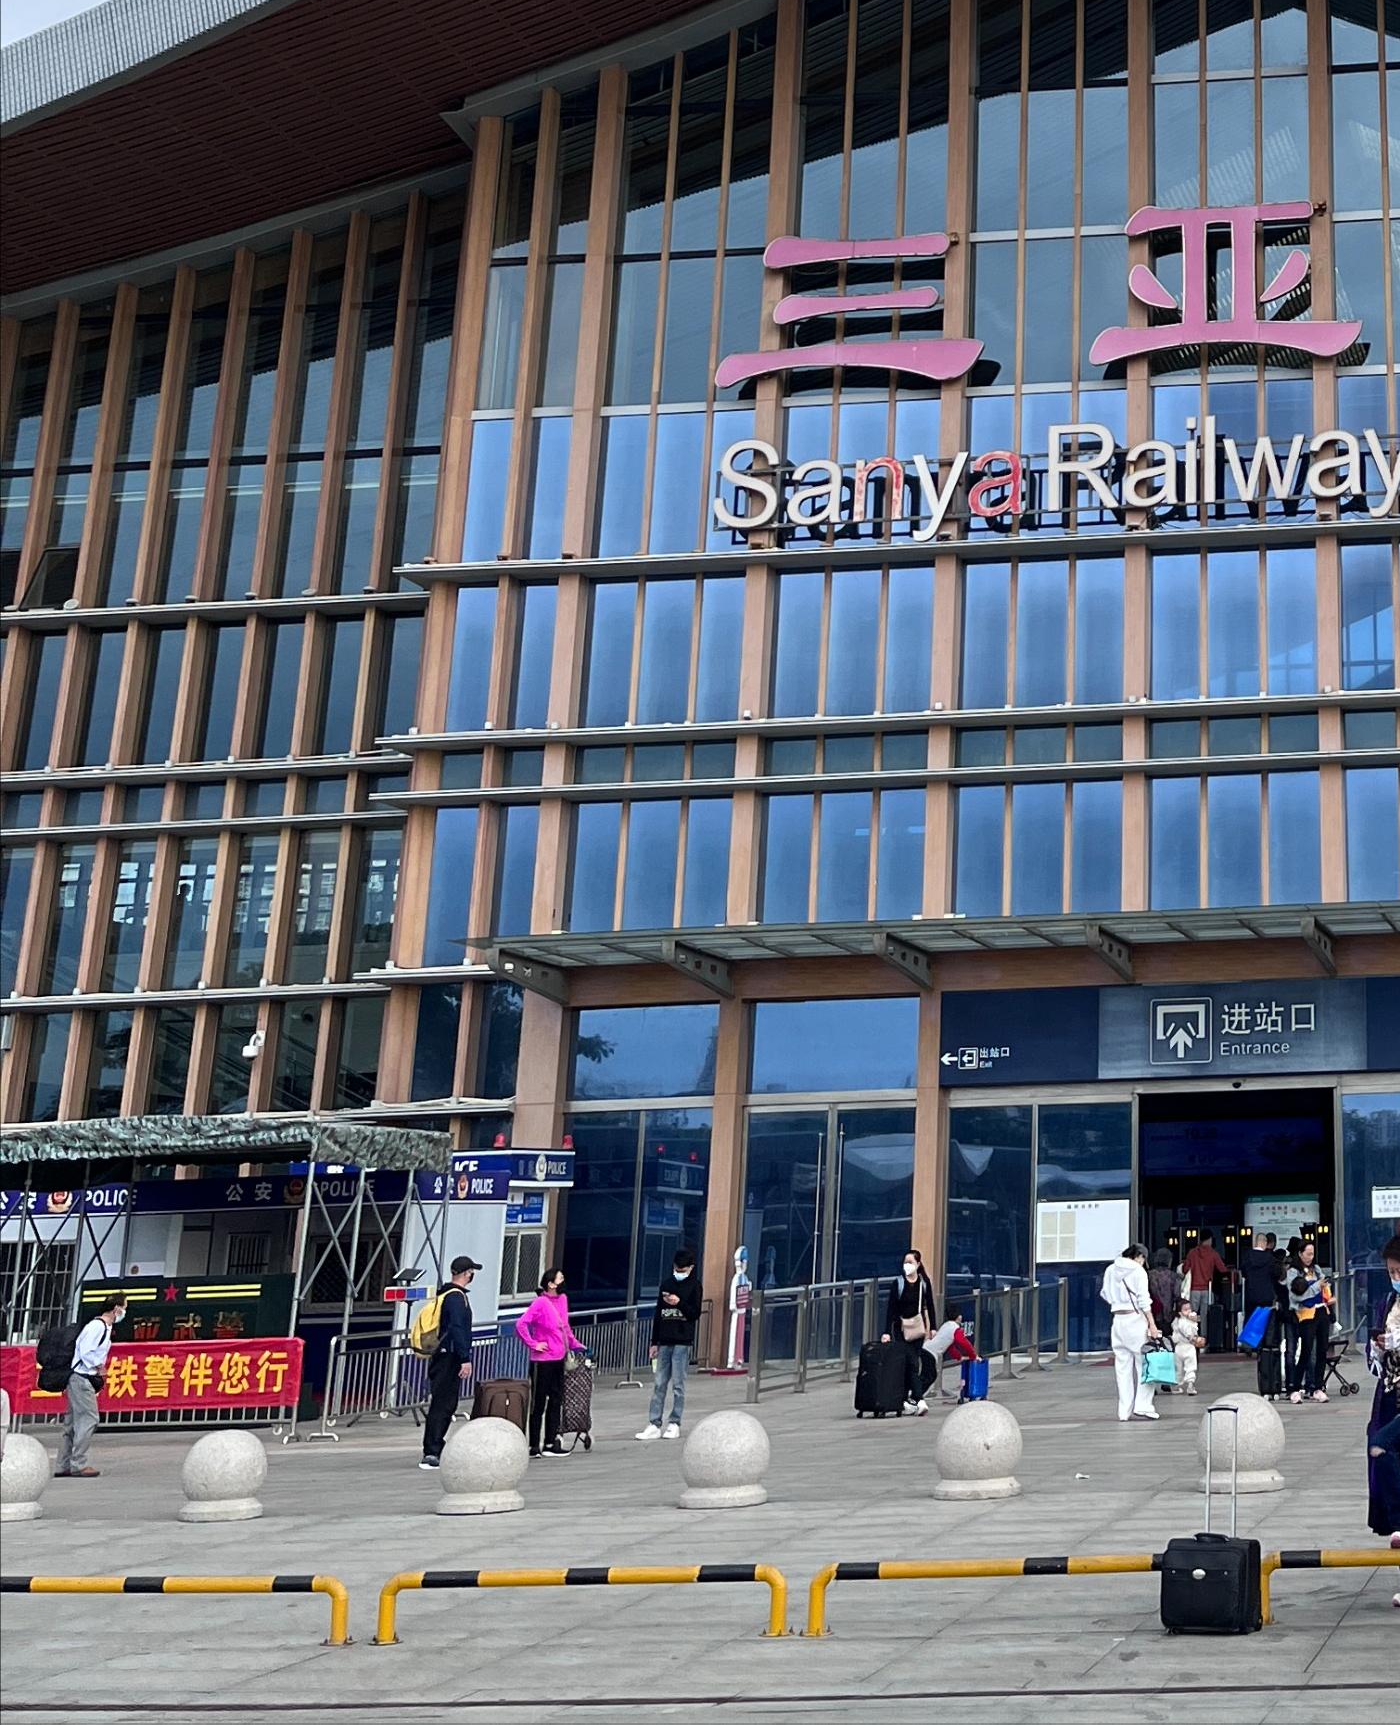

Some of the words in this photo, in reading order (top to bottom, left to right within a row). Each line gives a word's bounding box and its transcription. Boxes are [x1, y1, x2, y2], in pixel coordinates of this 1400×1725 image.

[712, 438, 1024, 542] Sanya
[1220, 1000, 1316, 1035] 进站口
[979, 1046, 1011, 1060] 出站口
[1220, 1041, 1291, 1056] Entrance
[979, 1060, 993, 1069] Exit
[547, 1161, 567, 1175] POLICE
[225, 1181, 273, 1202] 公安
[470, 1177, 494, 1194] POLICE
